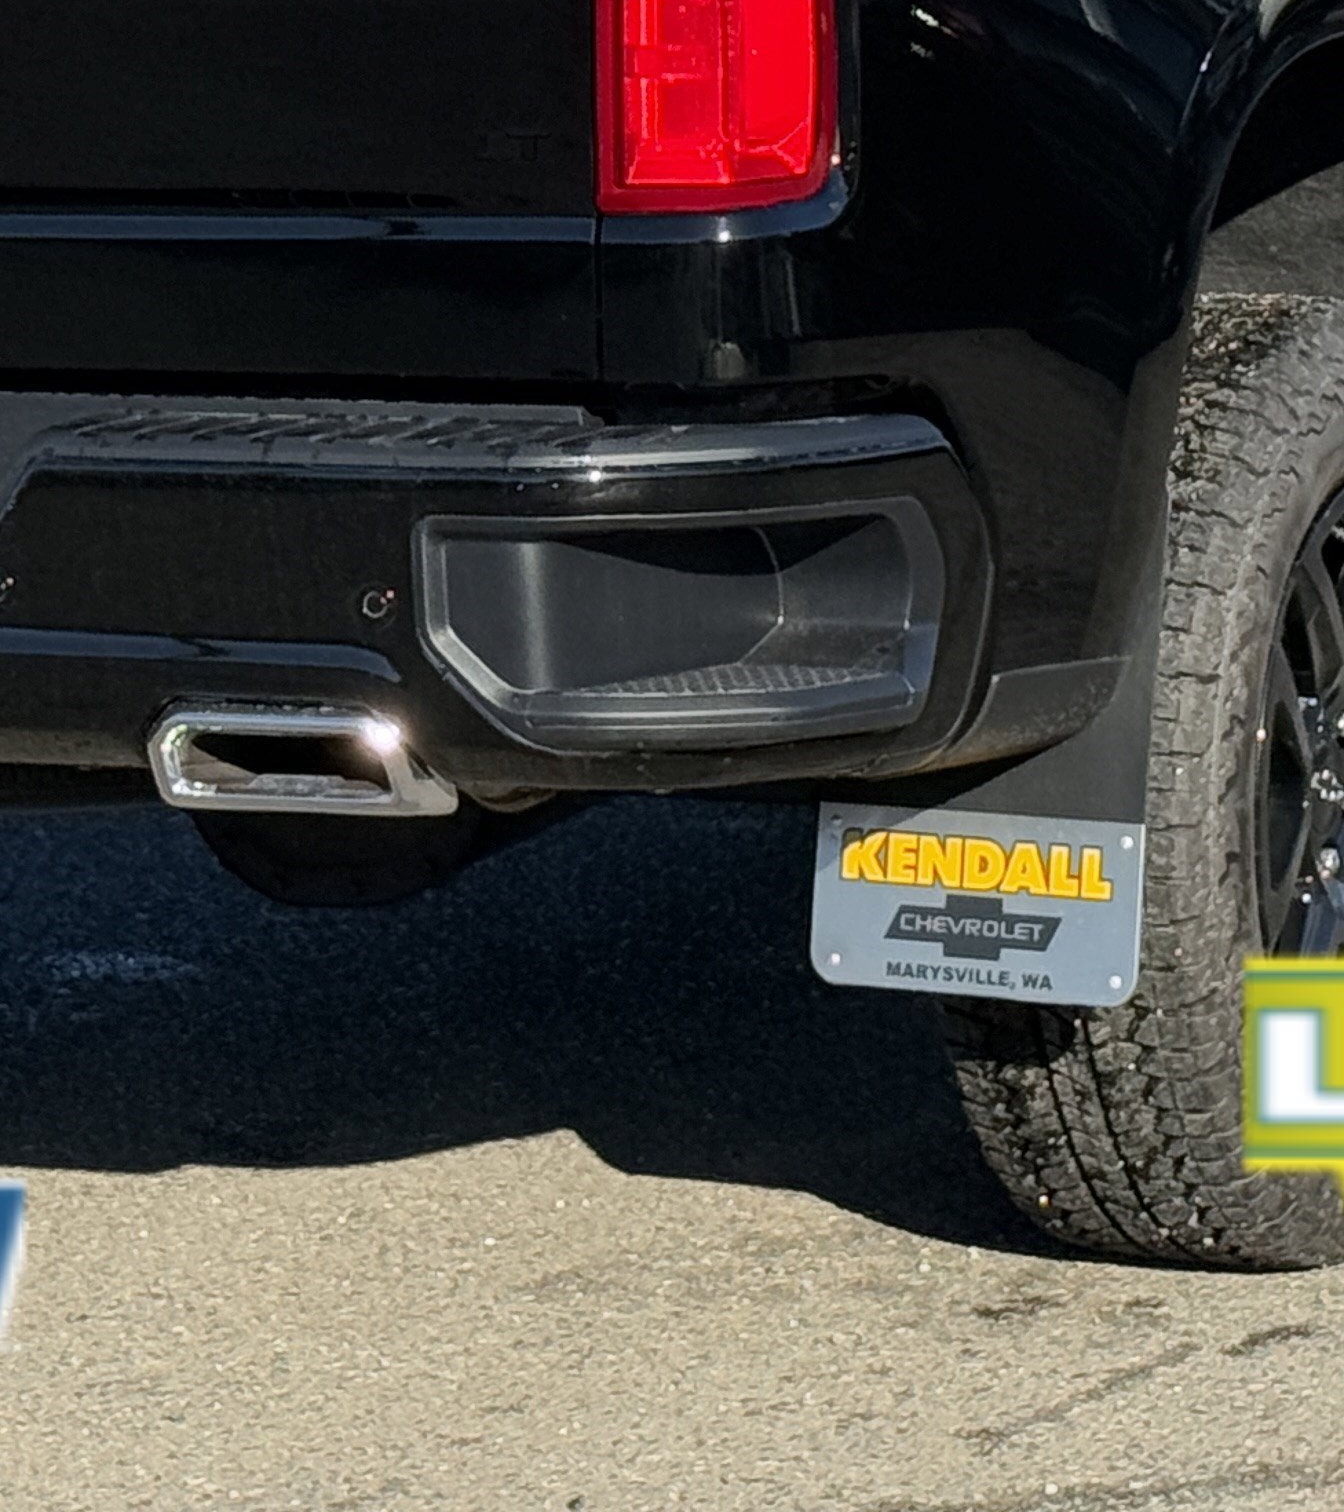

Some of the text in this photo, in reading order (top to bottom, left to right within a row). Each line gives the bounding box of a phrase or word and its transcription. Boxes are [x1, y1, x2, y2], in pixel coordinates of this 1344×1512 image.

[839, 826, 1113, 902] KENDALL
[899, 912, 1044, 943] CHEVROLET
[886, 961, 1053, 991] MARYSVILLE, WA
